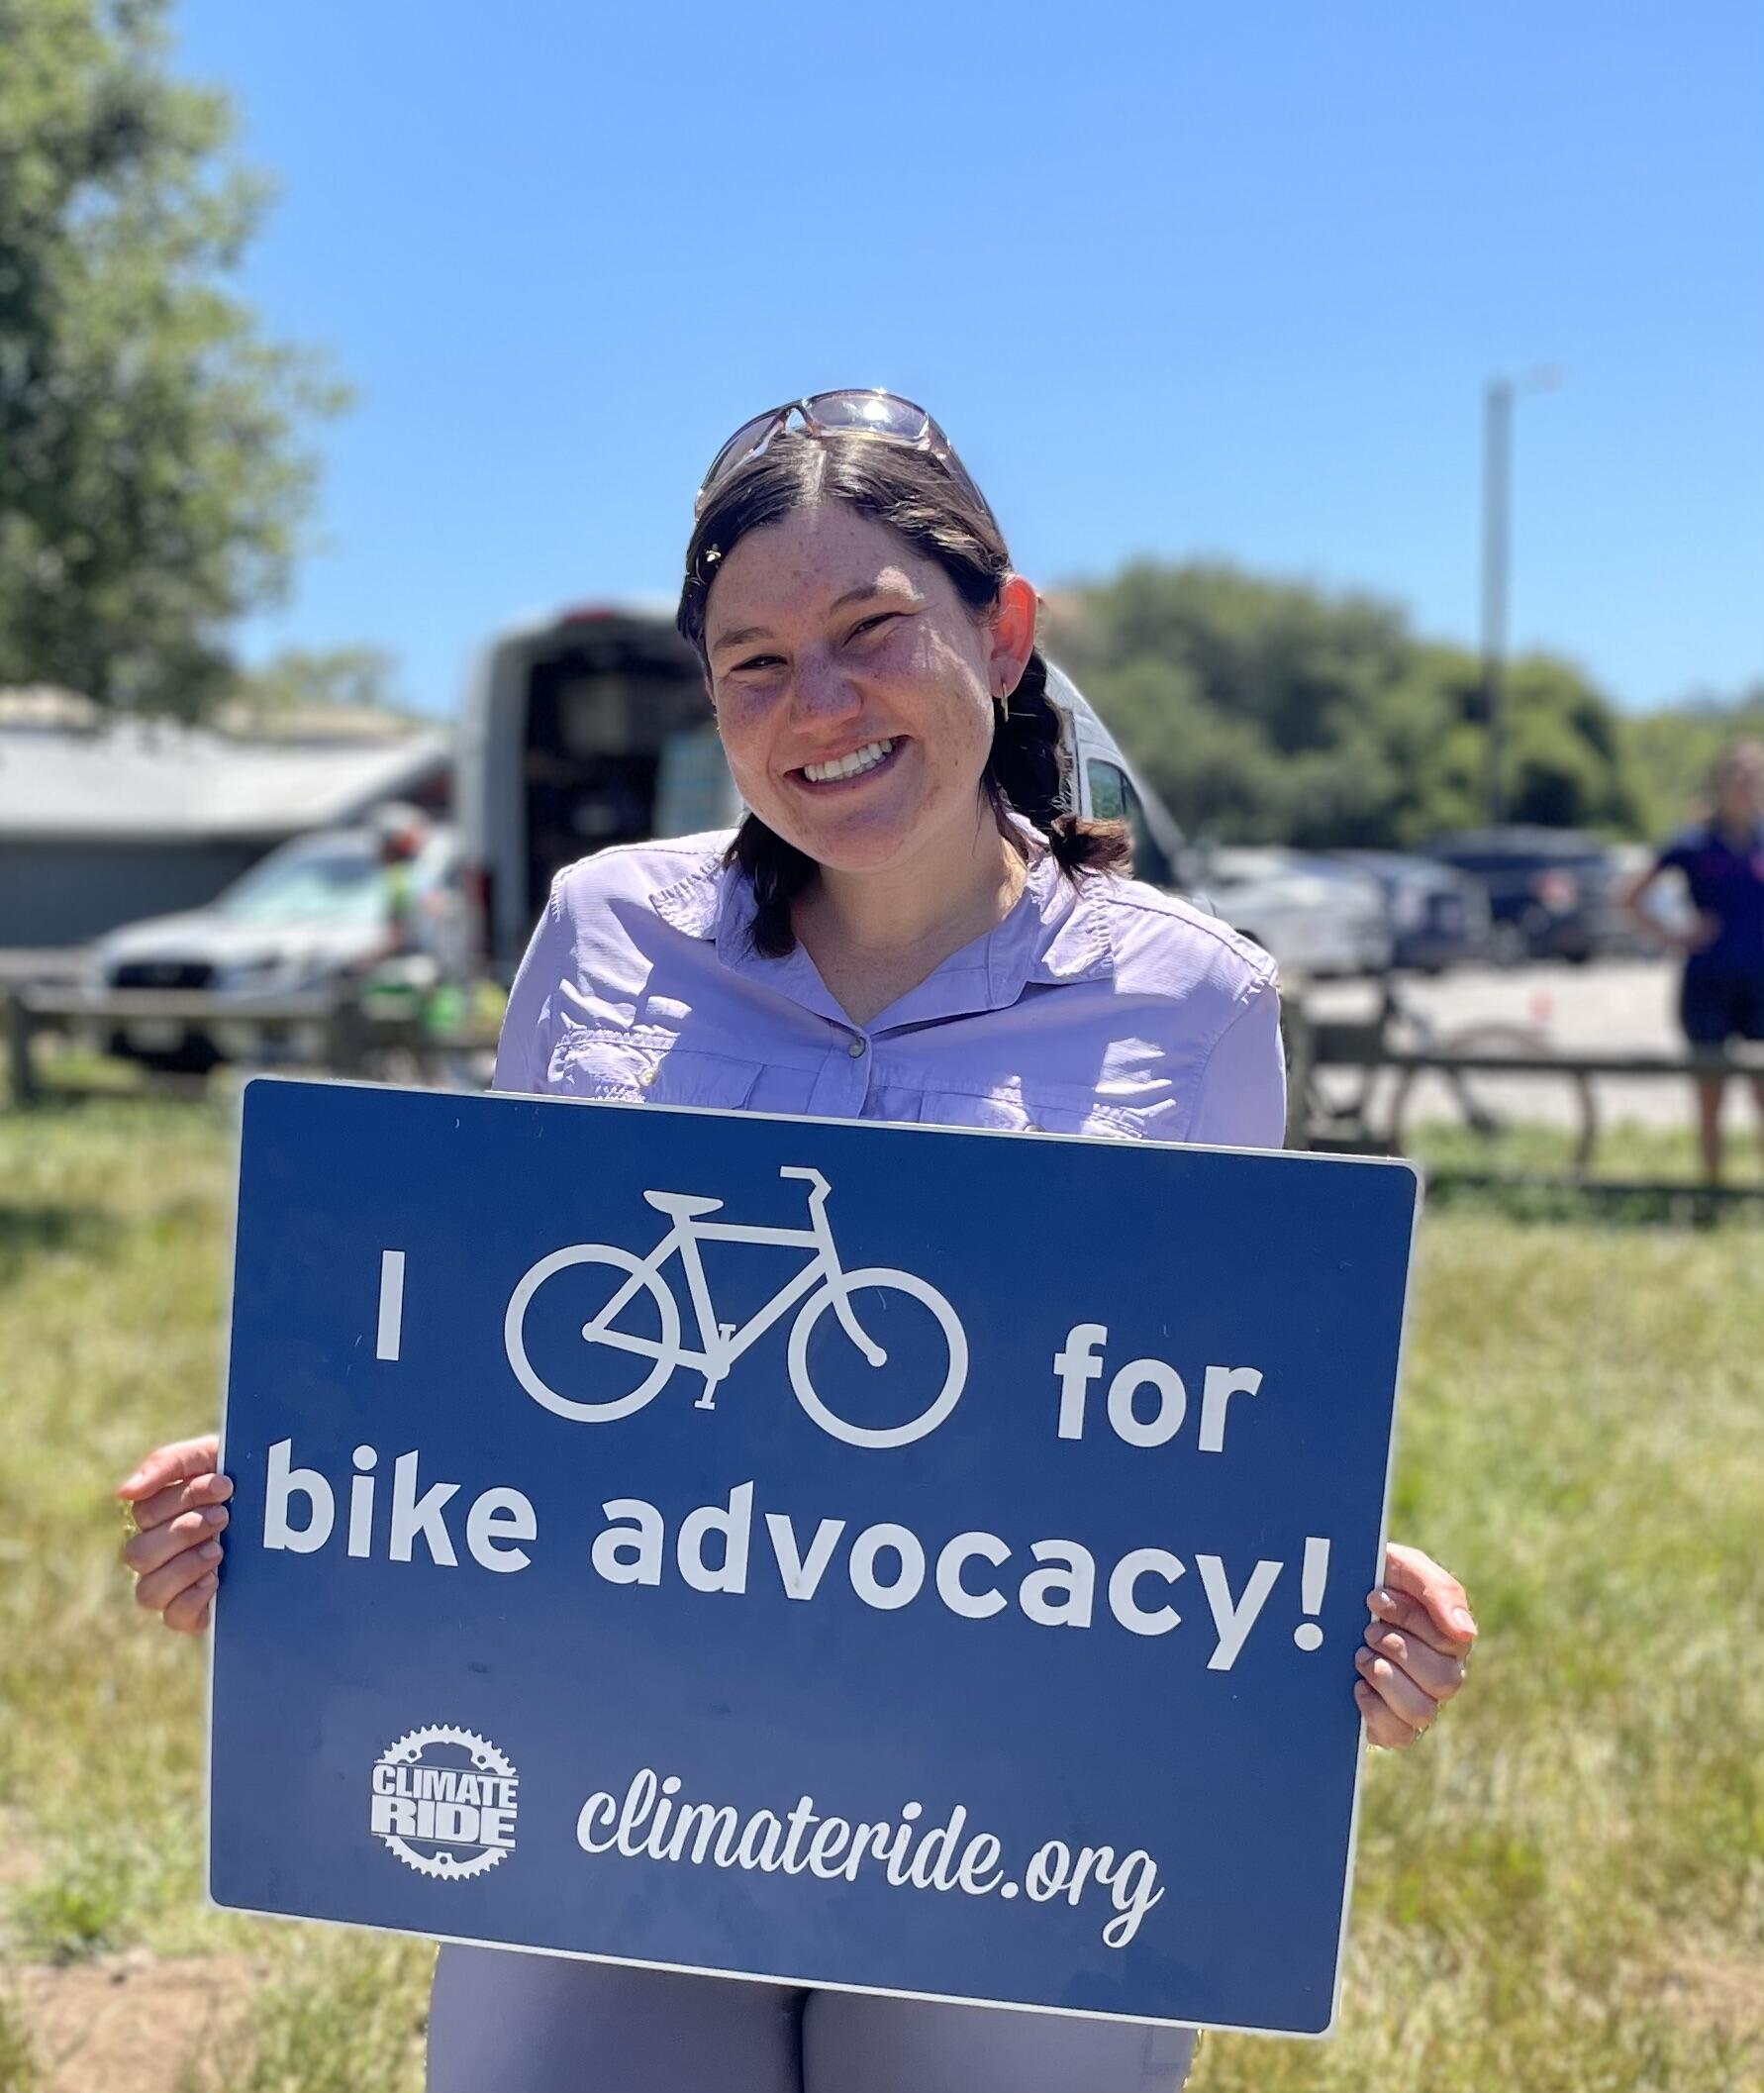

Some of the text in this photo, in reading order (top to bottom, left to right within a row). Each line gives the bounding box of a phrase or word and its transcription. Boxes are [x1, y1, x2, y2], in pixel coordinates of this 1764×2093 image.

[376, 1249, 1263, 1452] I for
[263, 1438, 1330, 1671] bike advocacy!
[370, 1794, 518, 1848] RIDE
[372, 1764, 520, 1810] CLIMATE
[576, 1768, 1165, 1948] climateride.org
